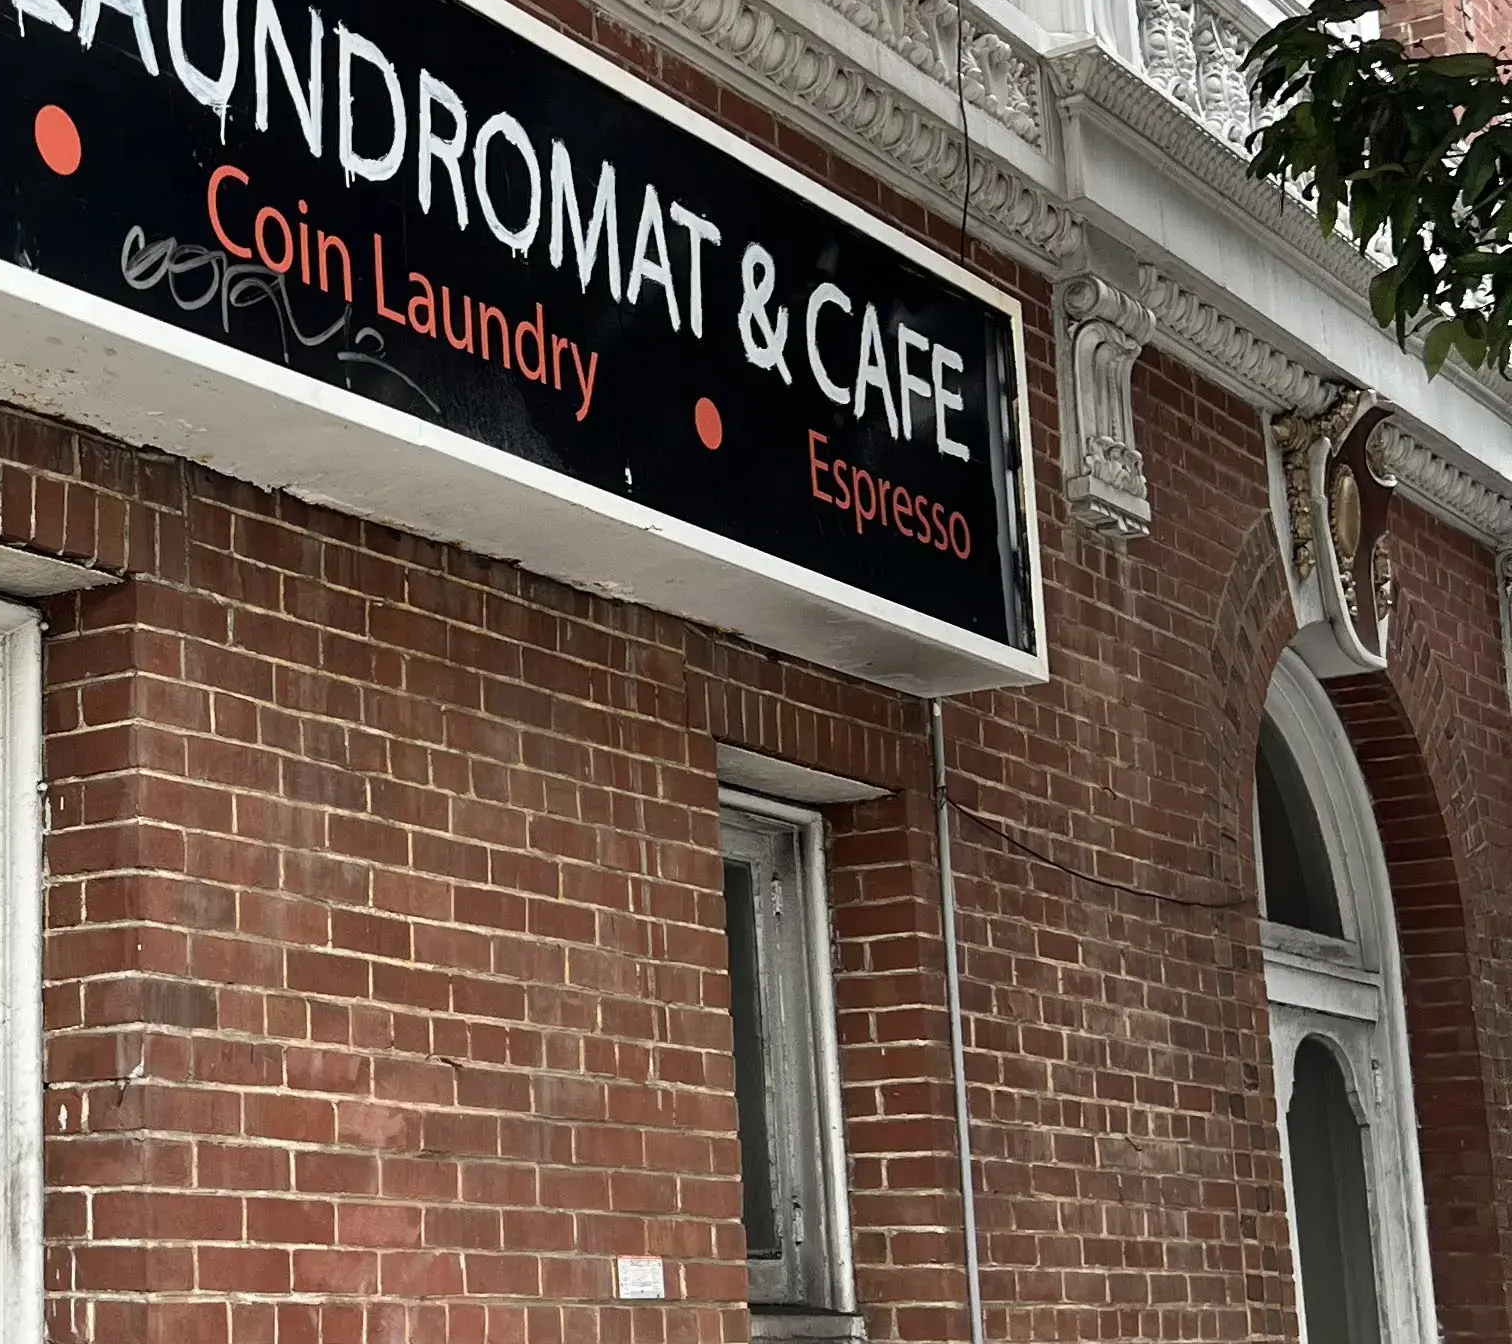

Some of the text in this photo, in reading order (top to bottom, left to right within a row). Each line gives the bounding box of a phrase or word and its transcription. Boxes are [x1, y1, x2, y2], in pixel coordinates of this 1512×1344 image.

[207, 164, 354, 304] Coin
[373, 233, 599, 422] Laundry
[807, 428, 972, 560] Espresso
[737, 241, 793, 386] &
[805, 281, 970, 463] CAFE
